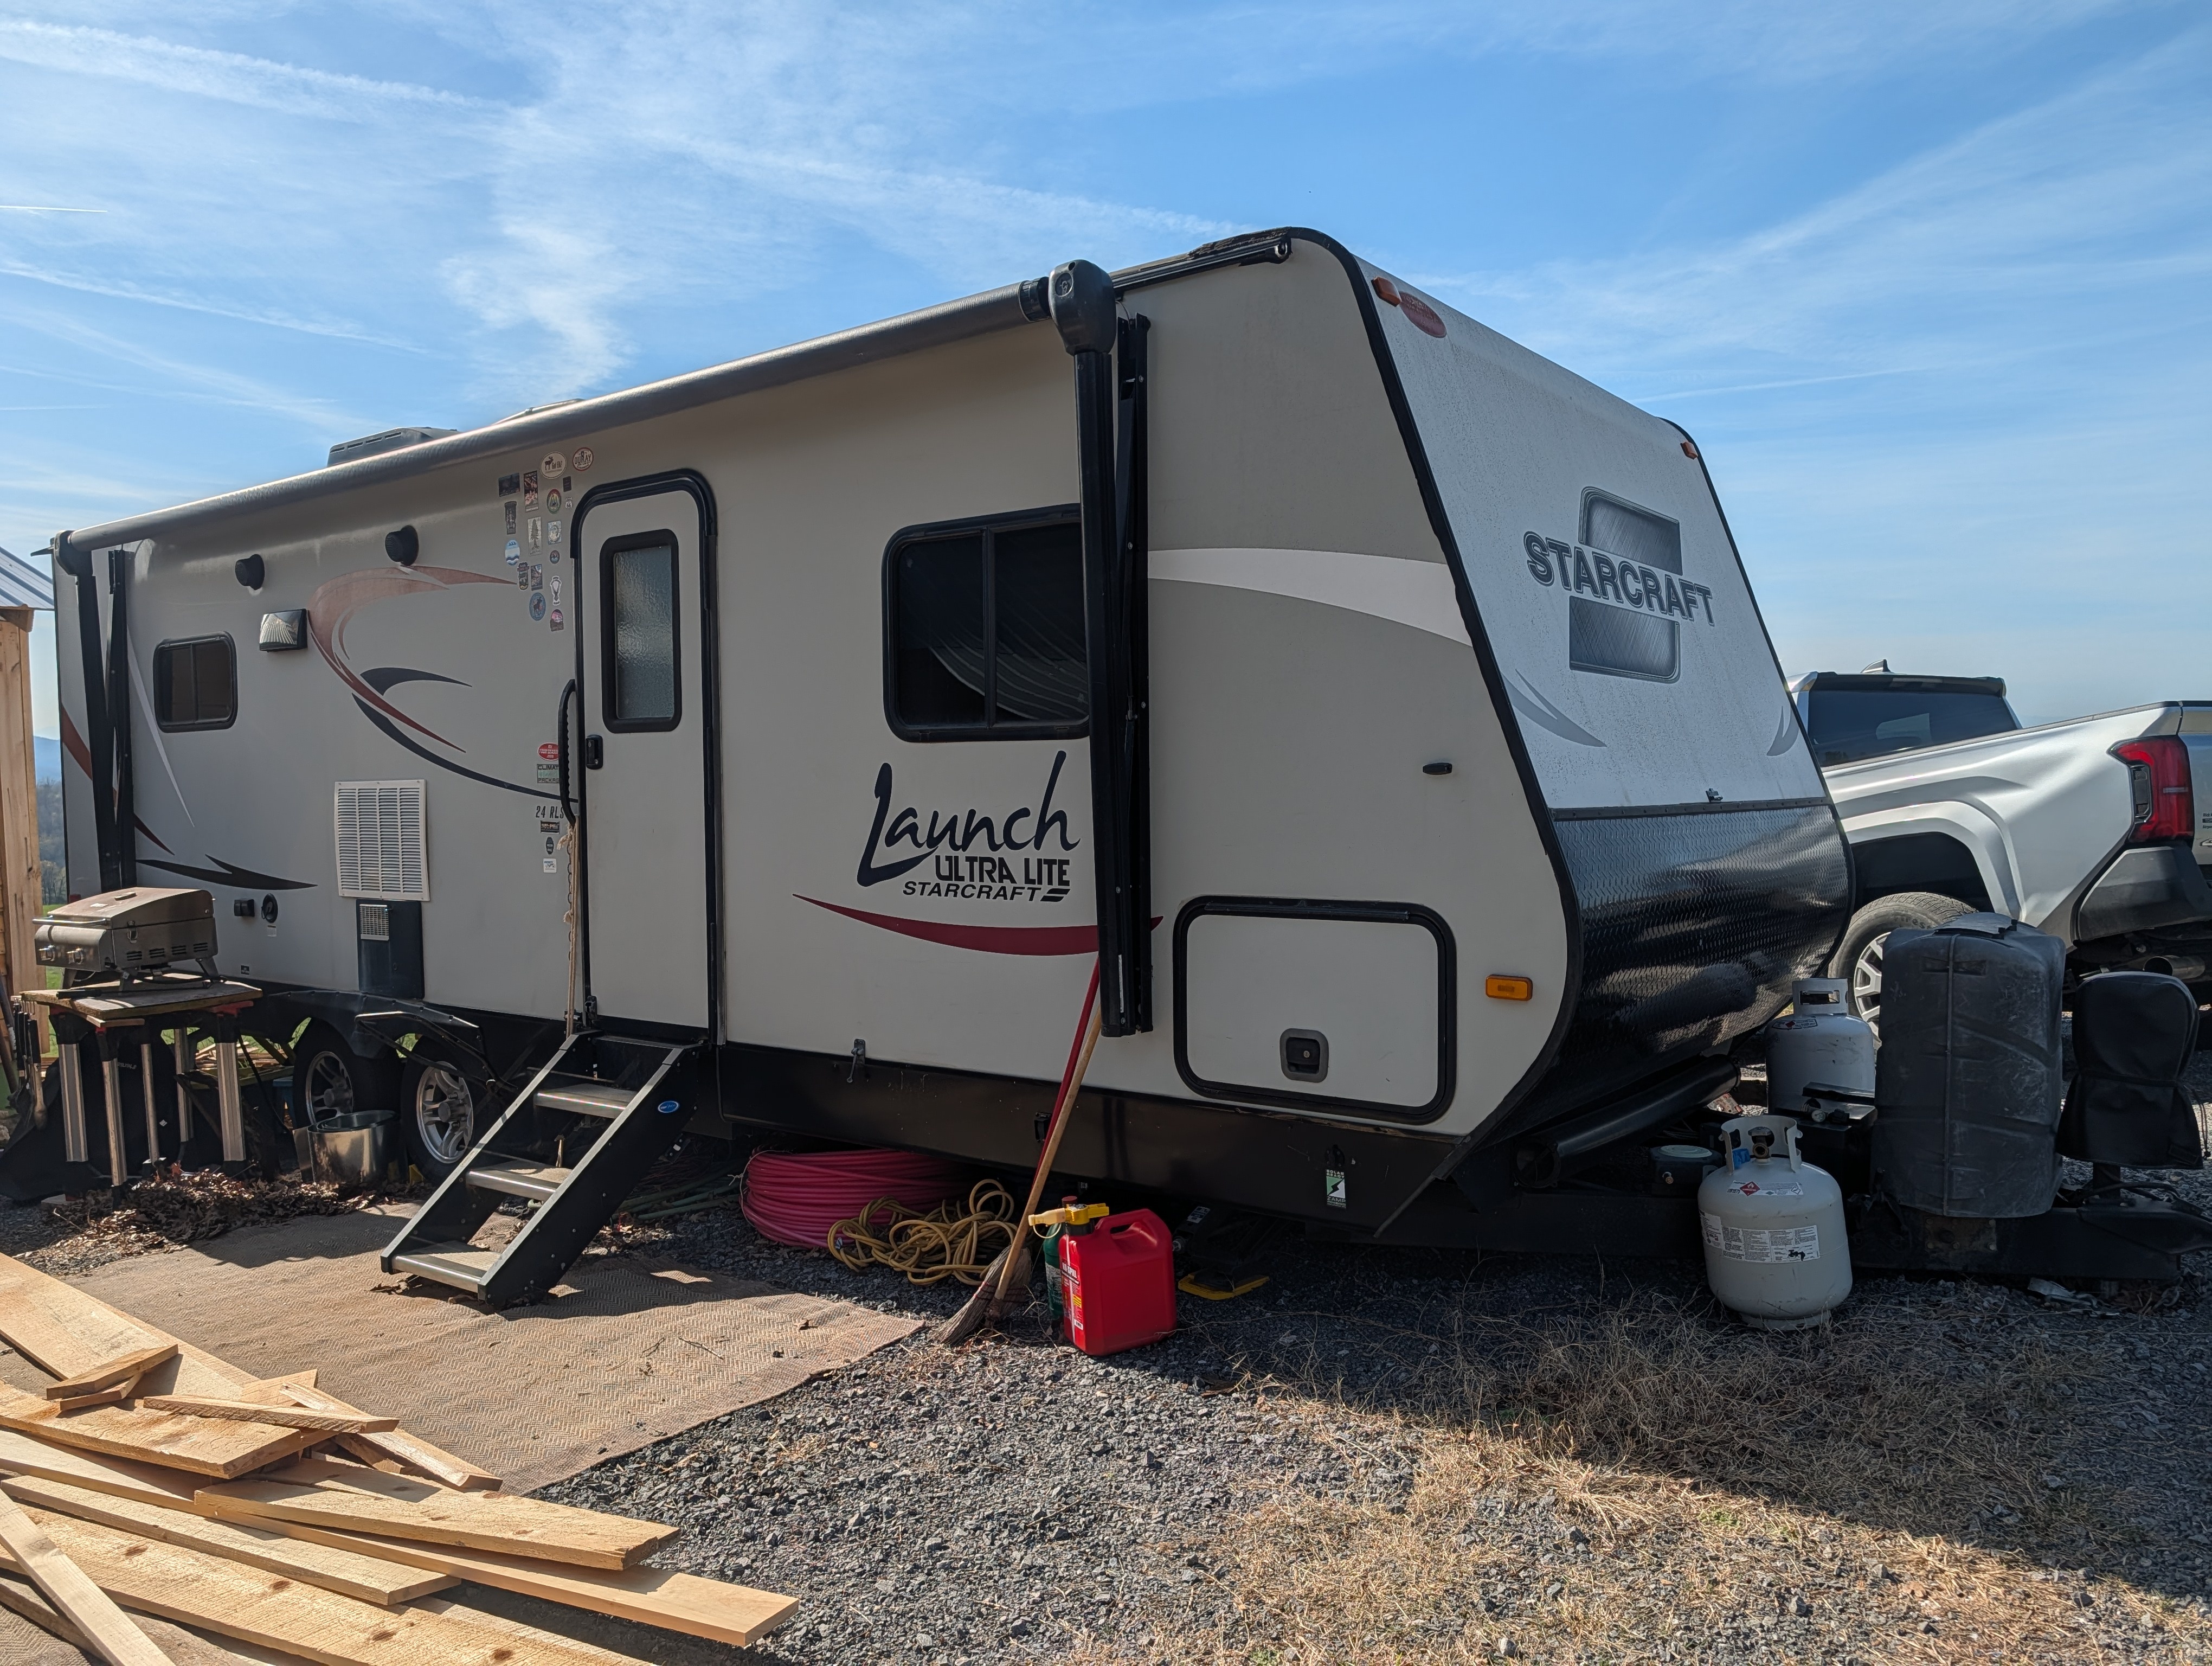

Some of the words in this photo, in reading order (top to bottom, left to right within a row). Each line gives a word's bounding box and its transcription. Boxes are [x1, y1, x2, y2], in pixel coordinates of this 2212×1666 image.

[575, 452, 591, 465] OURAY
[1523, 531, 1715, 626] STARCRAFT
[536, 805, 546, 818] 24
[549, 806, 564, 819] RLS
[857, 750, 1081, 887] Launch
[935, 855, 1017, 884] ULTRA
[1024, 858, 1071, 887] LITE
[902, 881, 1042, 902] STARCRAFT
